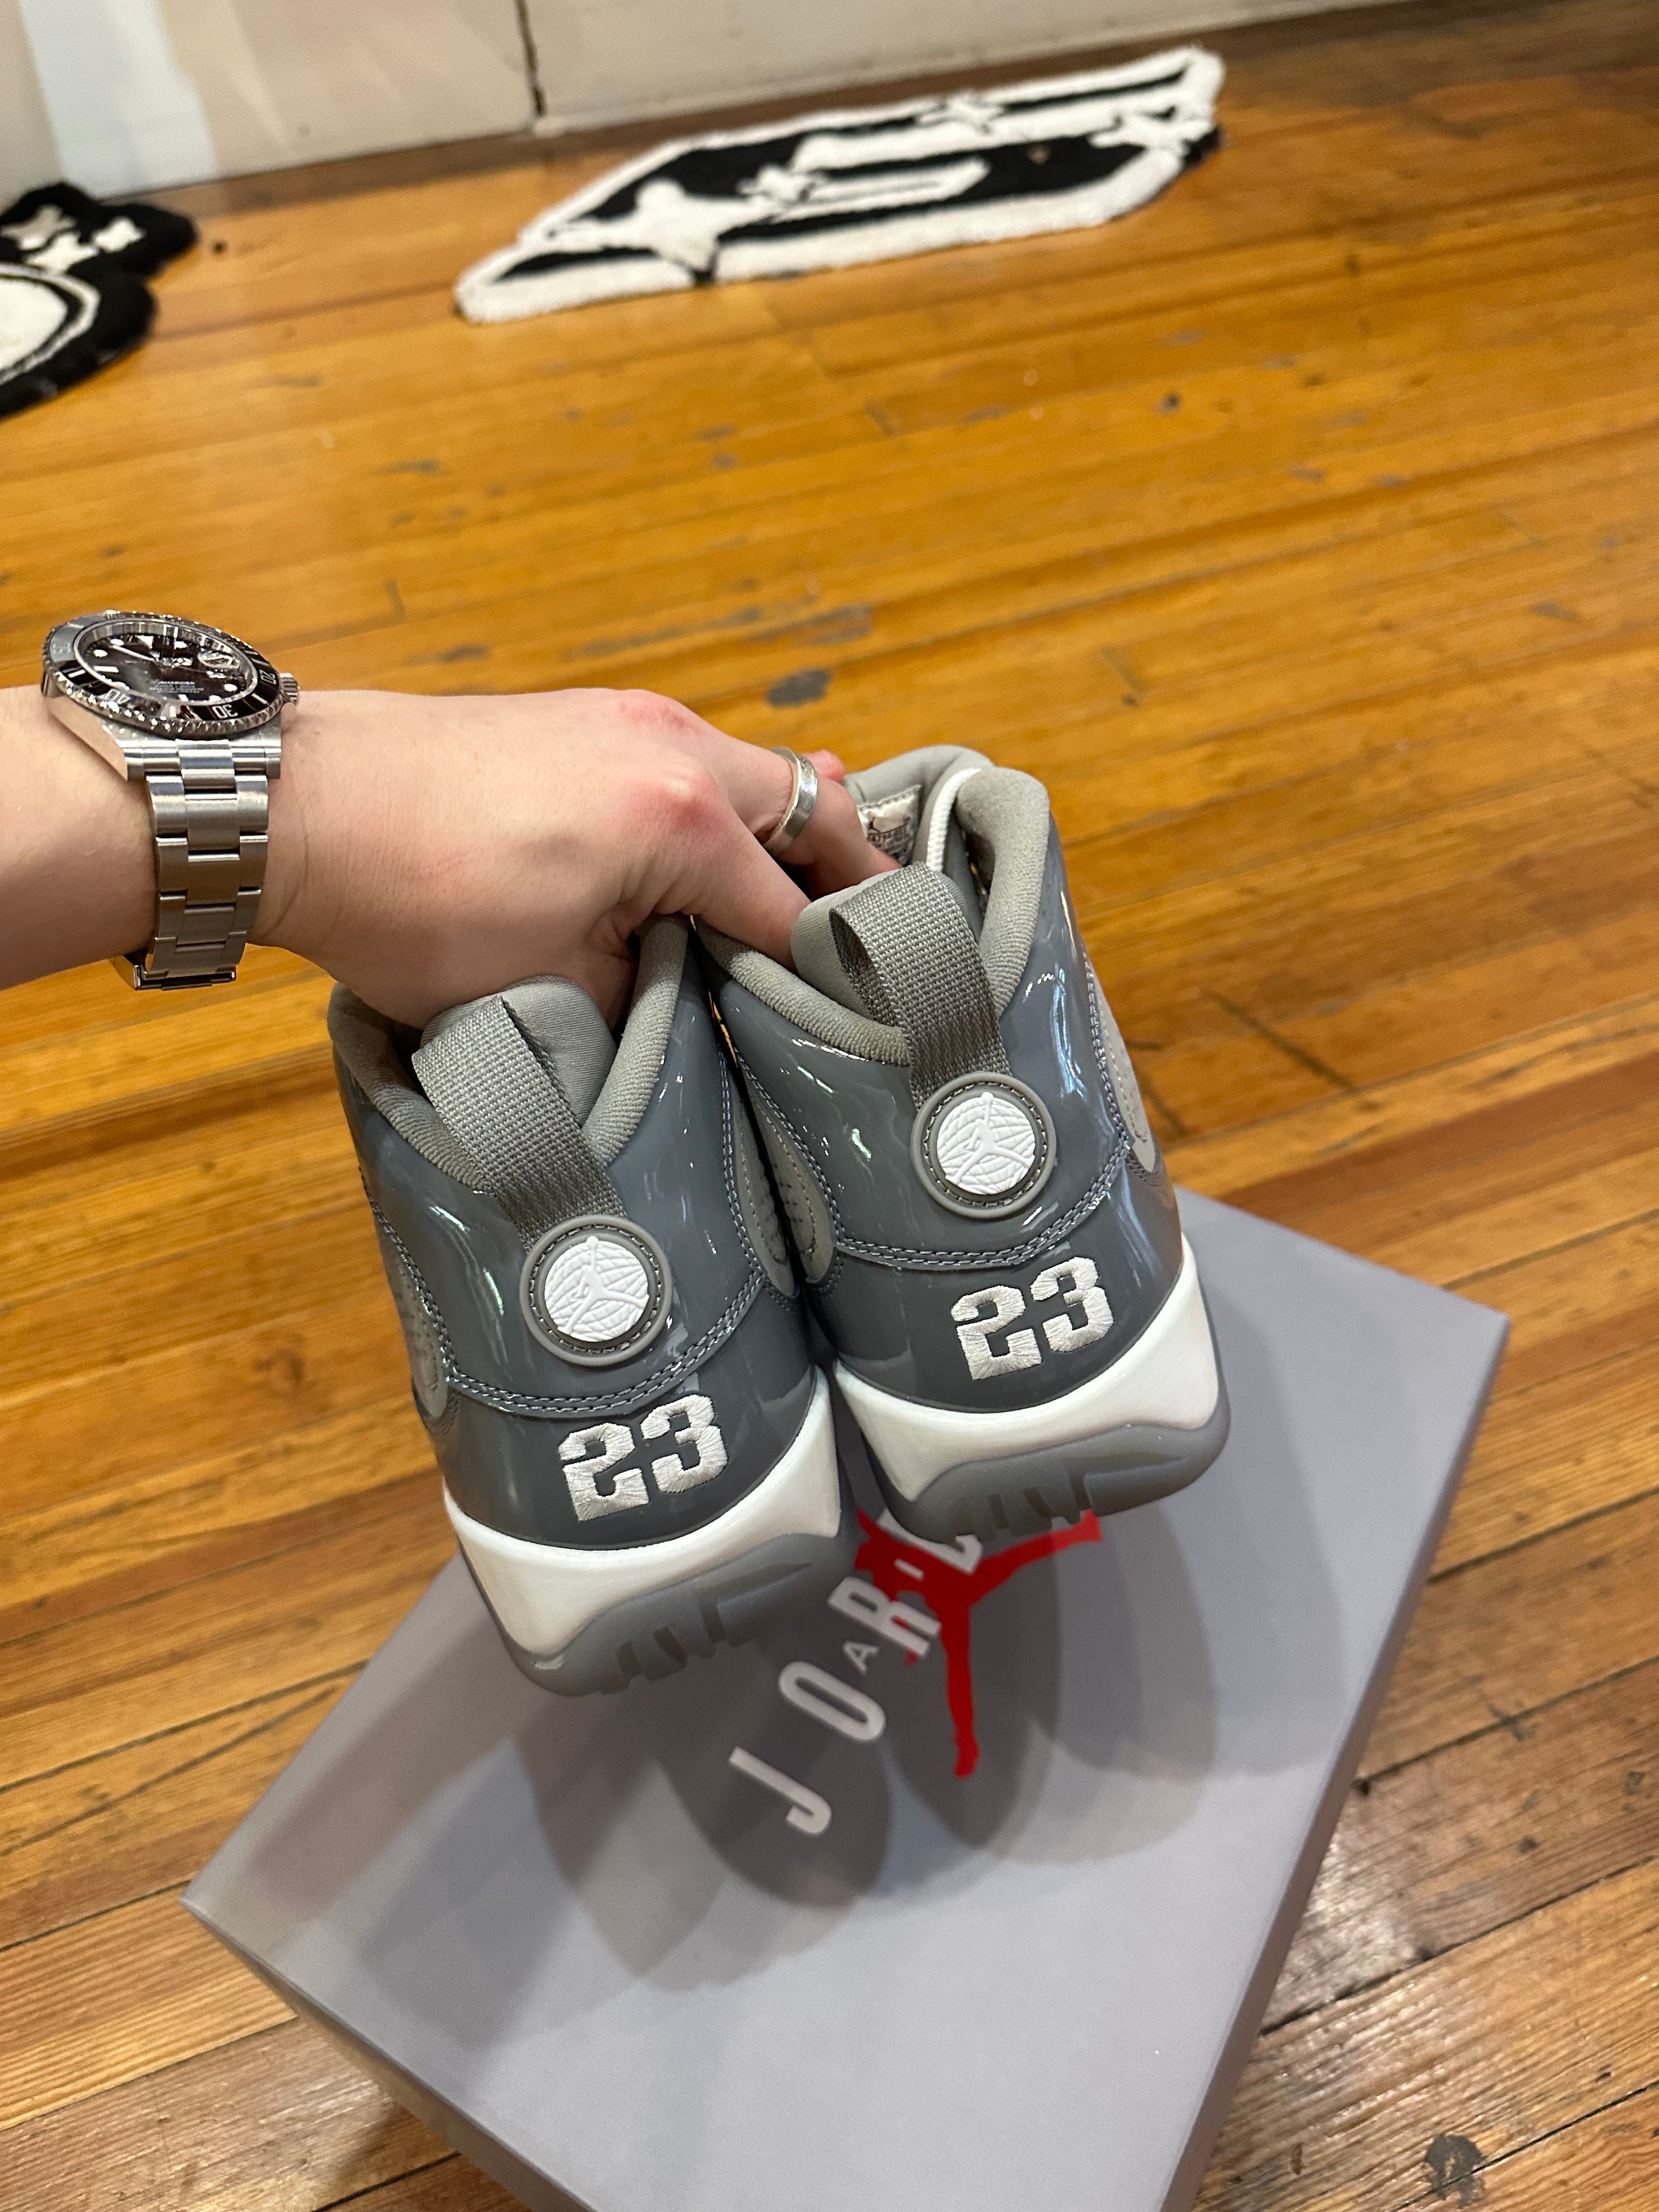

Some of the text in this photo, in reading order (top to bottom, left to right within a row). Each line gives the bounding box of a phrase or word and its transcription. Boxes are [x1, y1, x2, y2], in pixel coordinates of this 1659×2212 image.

[212, 704, 238, 719] 30
[951, 1256, 1114, 1380] 23
[558, 1394, 728, 1522] 23
